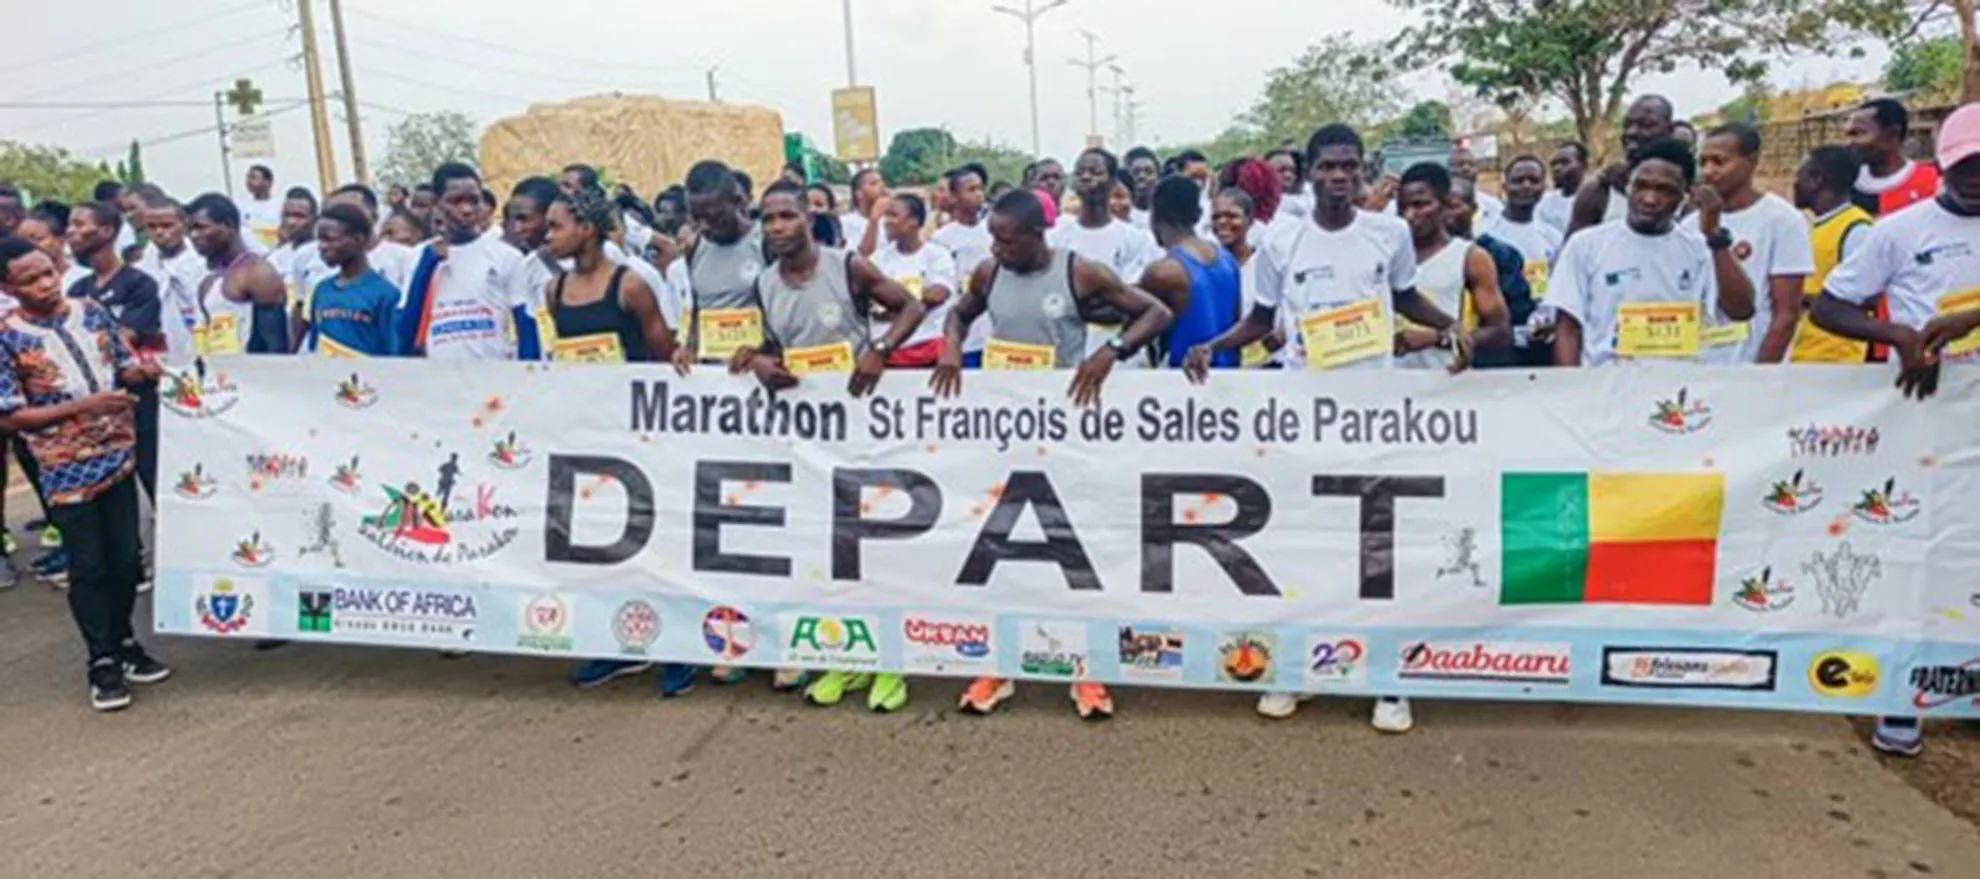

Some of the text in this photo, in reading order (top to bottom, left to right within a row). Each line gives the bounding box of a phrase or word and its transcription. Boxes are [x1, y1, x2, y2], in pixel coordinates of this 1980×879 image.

[631, 380, 1477, 451] Marathon St François de Sales de Parakou
[545, 455, 1445, 600] DEPART
[334, 588, 476, 617] BANK OF AFRICA
